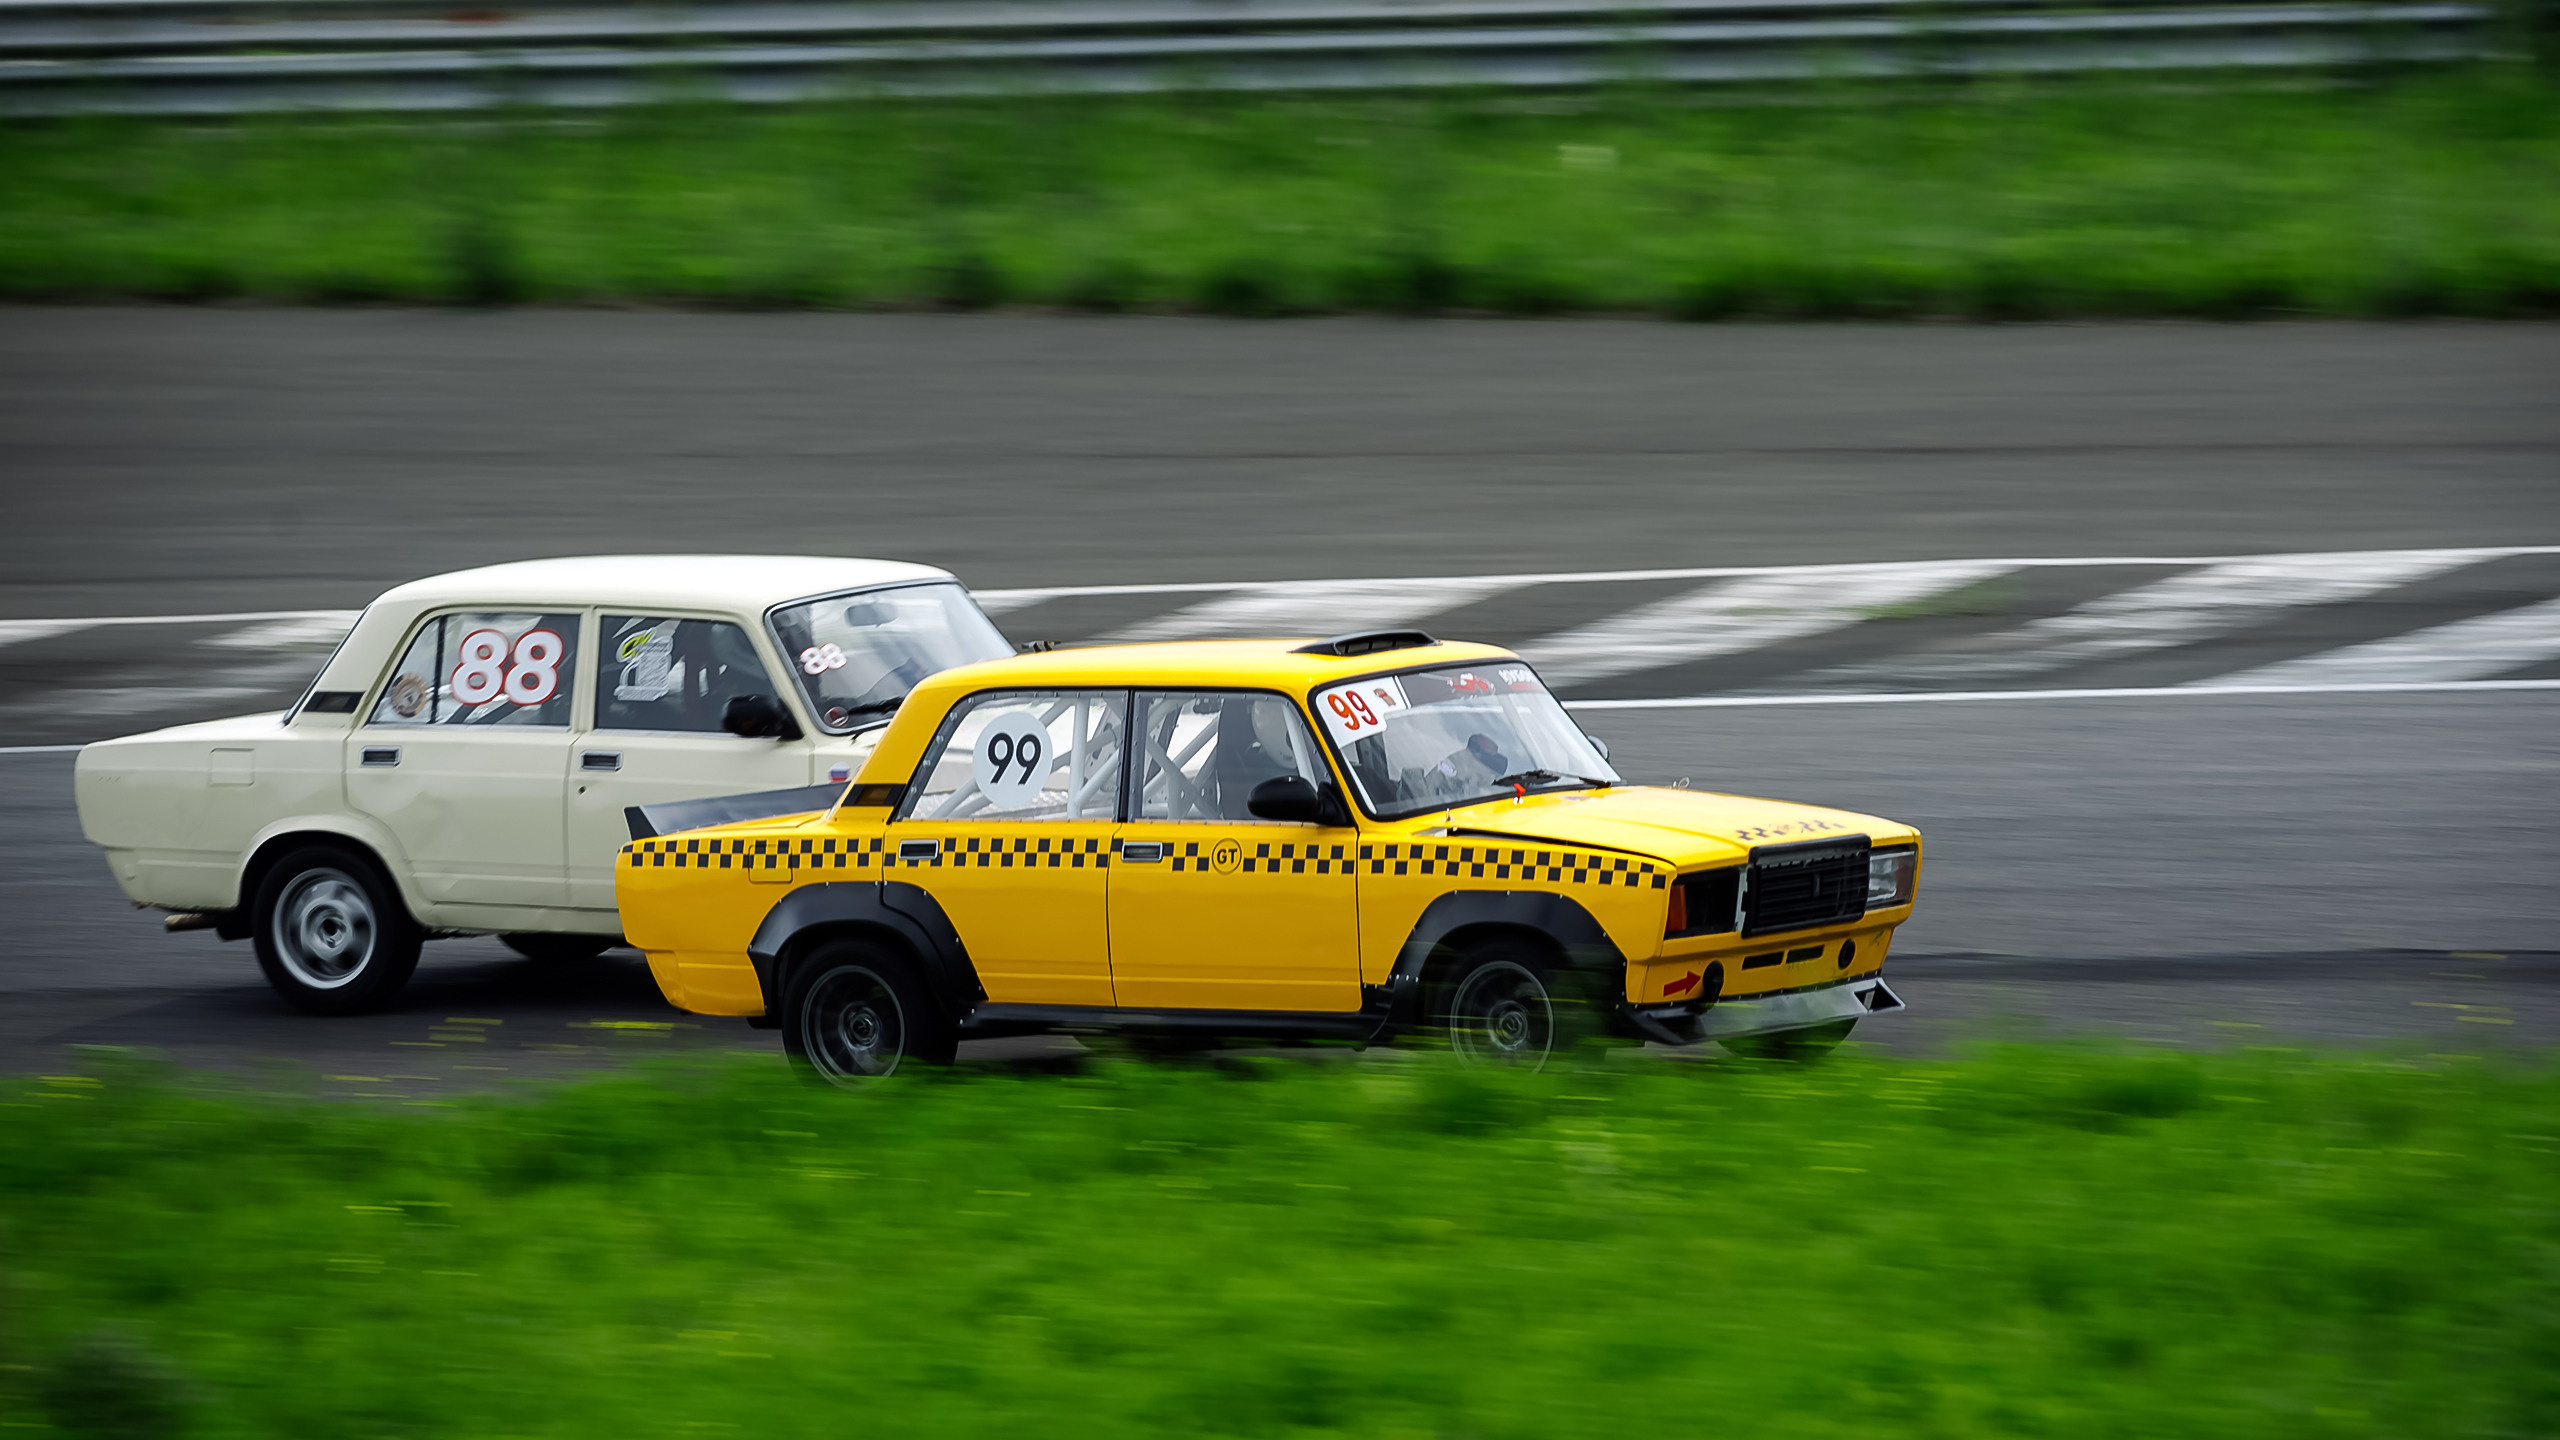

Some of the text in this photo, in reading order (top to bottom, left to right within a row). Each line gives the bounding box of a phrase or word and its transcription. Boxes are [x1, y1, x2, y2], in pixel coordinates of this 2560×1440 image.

[450, 628, 565, 706] 88
[800, 643, 847, 675] 88
[1327, 690, 1378, 730] 99
[987, 732, 1042, 785] 99
[1216, 848, 1238, 864] GT
